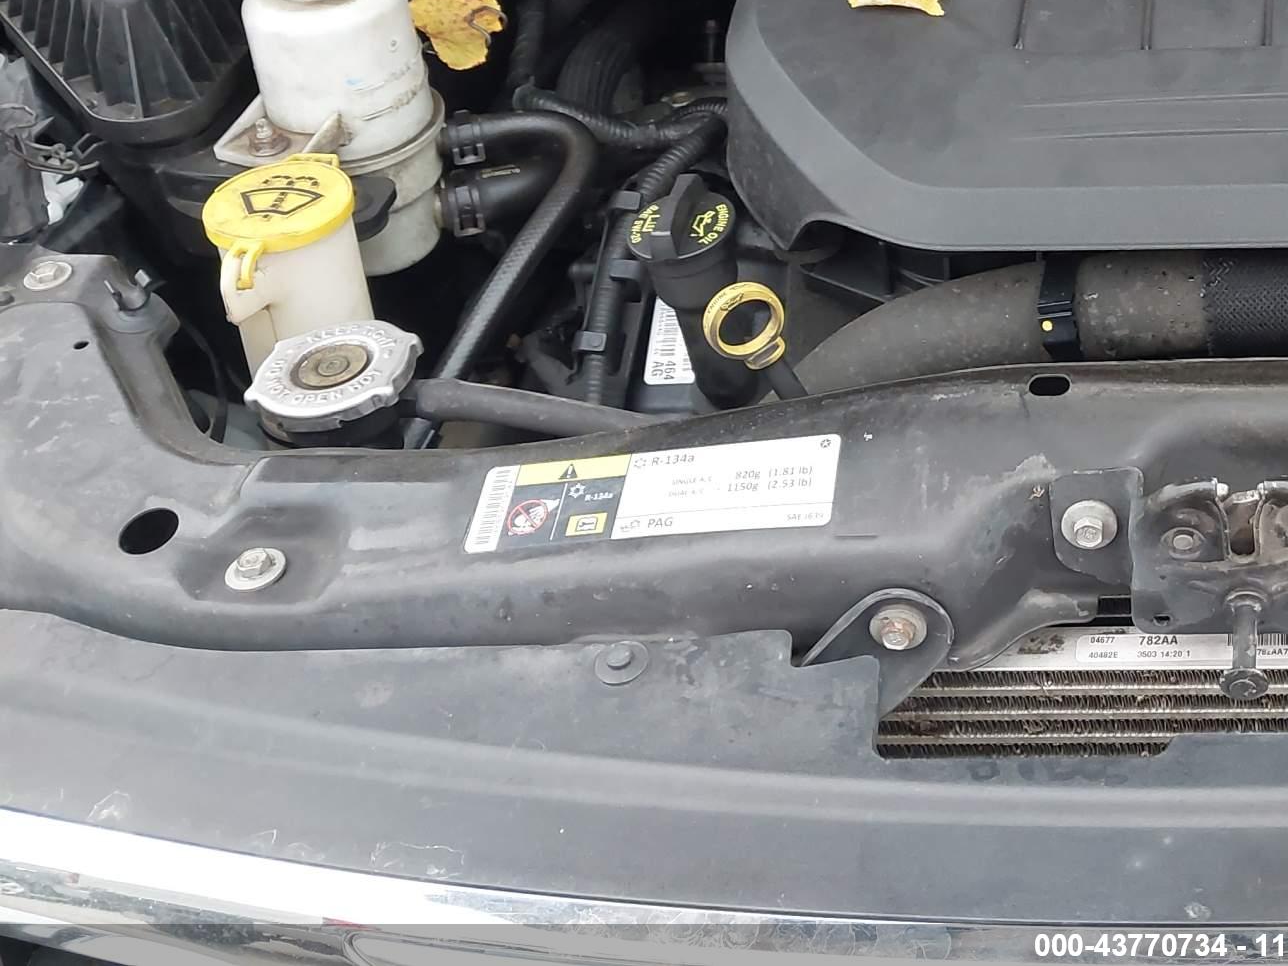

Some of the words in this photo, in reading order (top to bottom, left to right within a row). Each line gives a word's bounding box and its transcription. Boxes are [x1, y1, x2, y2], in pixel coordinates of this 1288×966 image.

[715, 203, 730, 232] ENGINE
[697, 232, 719, 245] OIL
[651, 361, 665, 377] AG
[664, 361, 677, 380] 464
[292, 390, 343, 404] OPEN
[651, 454, 695, 467] R-134a
[735, 469, 761, 480] 820g
[768, 467, 796, 478] (1.81
[798, 465, 813, 476] lb)
[727, 483, 760, 493] 1150g
[767, 480, 796, 491] (2.53
[798, 479, 813, 489] lb)
[647, 517, 674, 529] PAG
[1090, 636, 1116, 644] 04677
[1139, 635, 1178, 646] 782AA
[1160, 650, 1183, 658] 14:20
